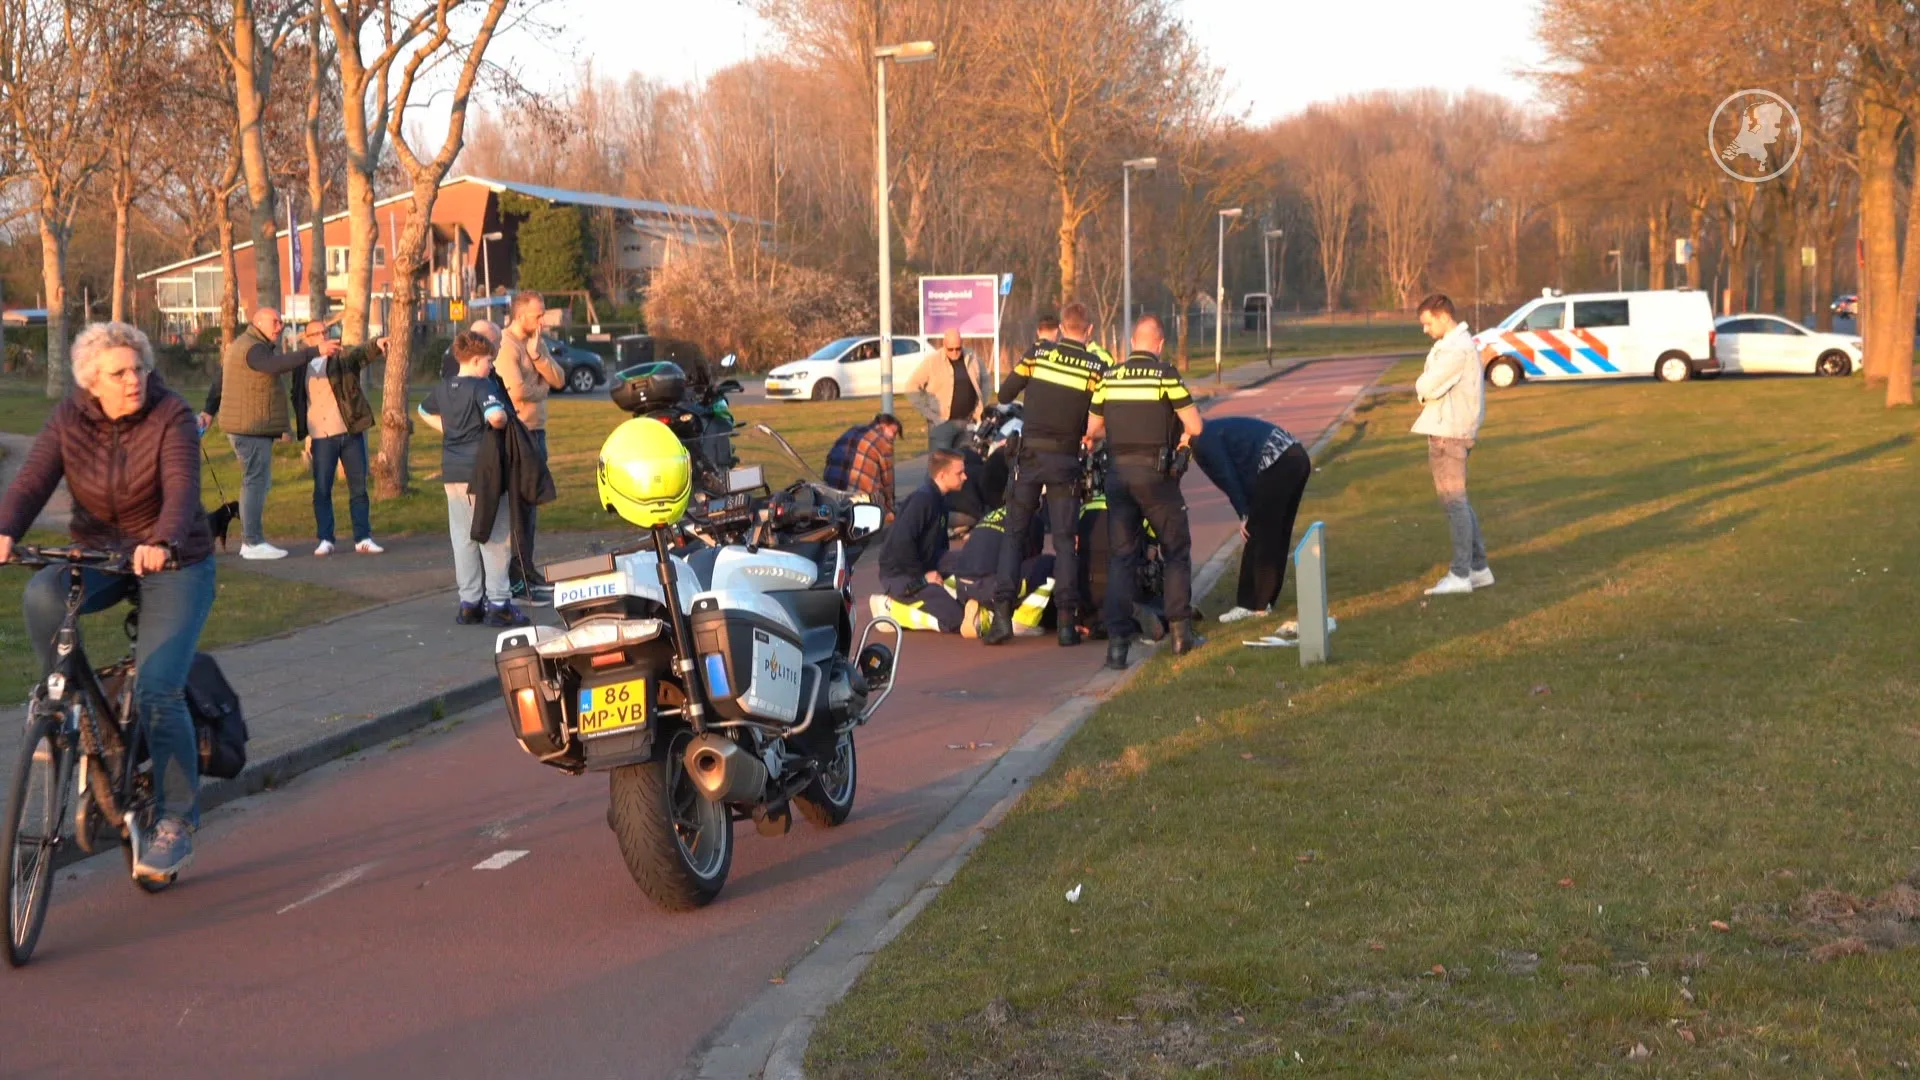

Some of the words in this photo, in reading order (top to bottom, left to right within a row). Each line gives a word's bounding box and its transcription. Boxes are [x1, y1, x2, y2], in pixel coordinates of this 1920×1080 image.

[561, 583, 617, 602] POLITIE
[764, 659, 797, 685] POLITIE
[604, 685, 630, 704] 86
[582, 703, 642, 731] MP-VB
